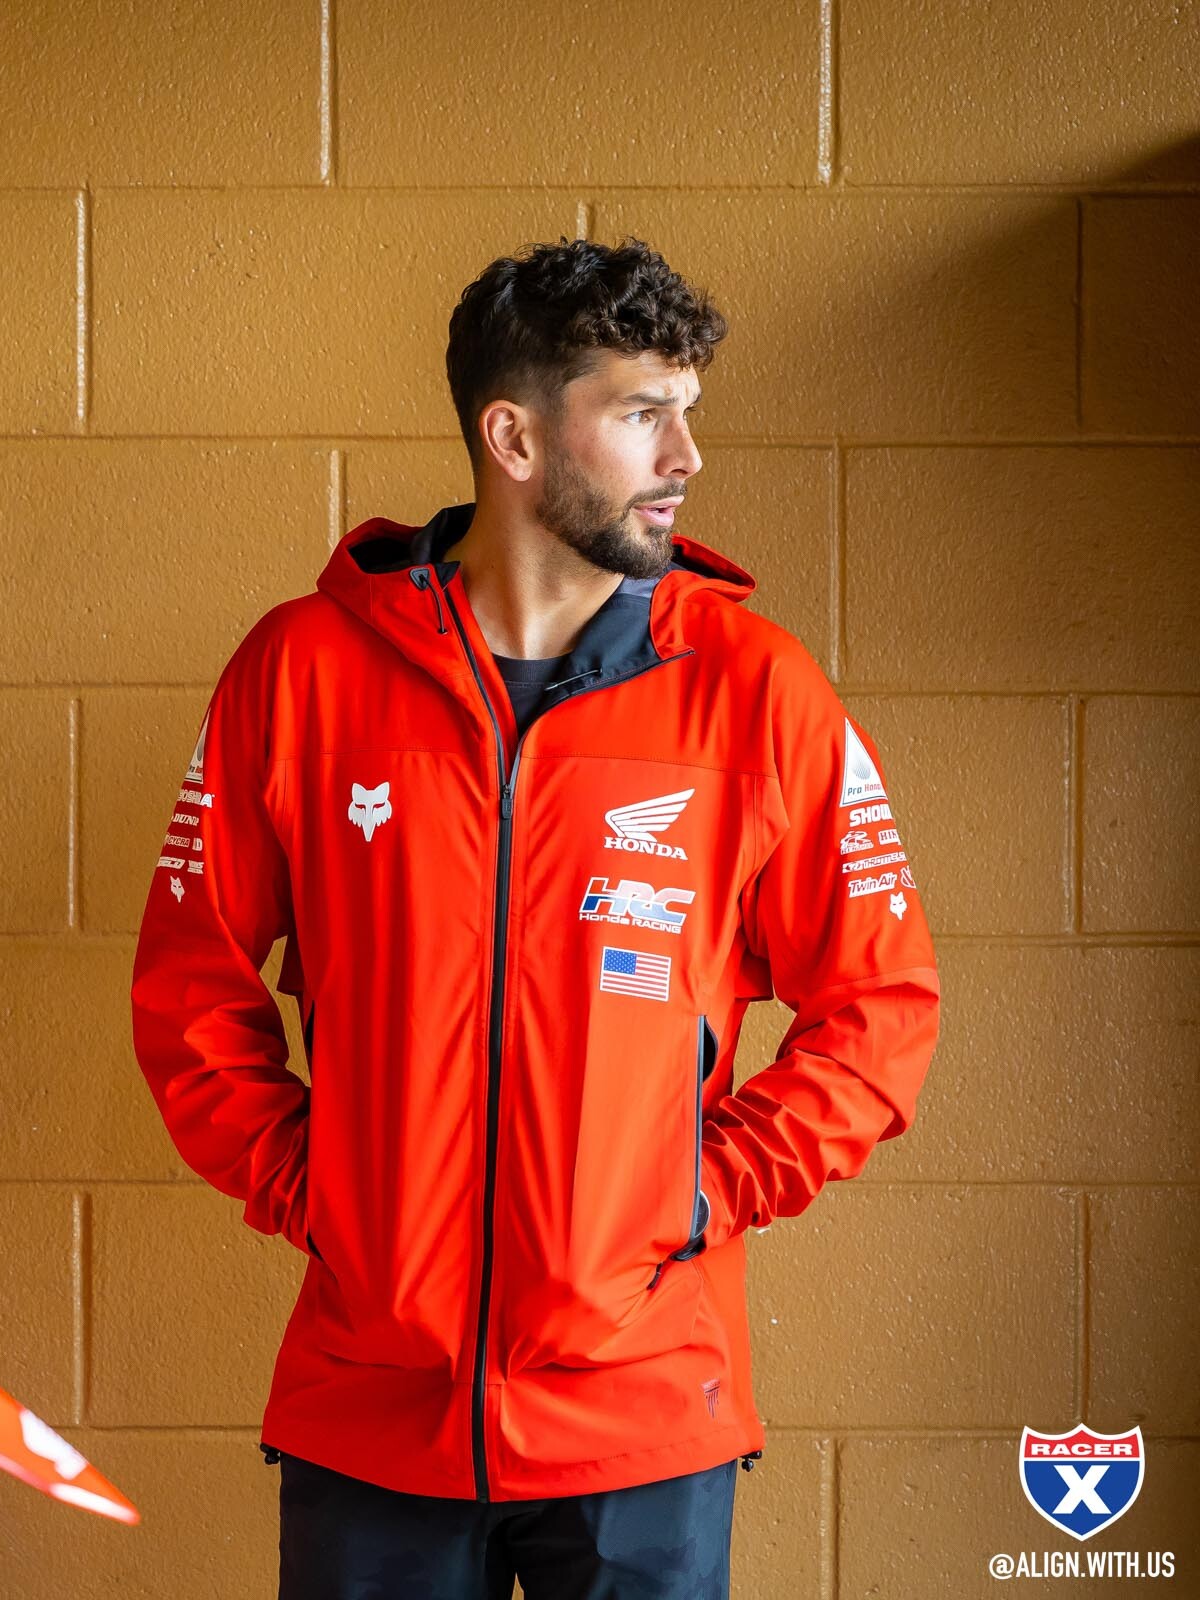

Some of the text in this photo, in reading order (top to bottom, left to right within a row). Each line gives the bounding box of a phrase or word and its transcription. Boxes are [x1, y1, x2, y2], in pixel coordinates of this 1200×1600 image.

[604, 837, 688, 860] HONDA
[851, 874, 896, 894] Twin Air
[579, 877, 696, 926] HRC
[580, 913, 681, 934] Honda RACING
